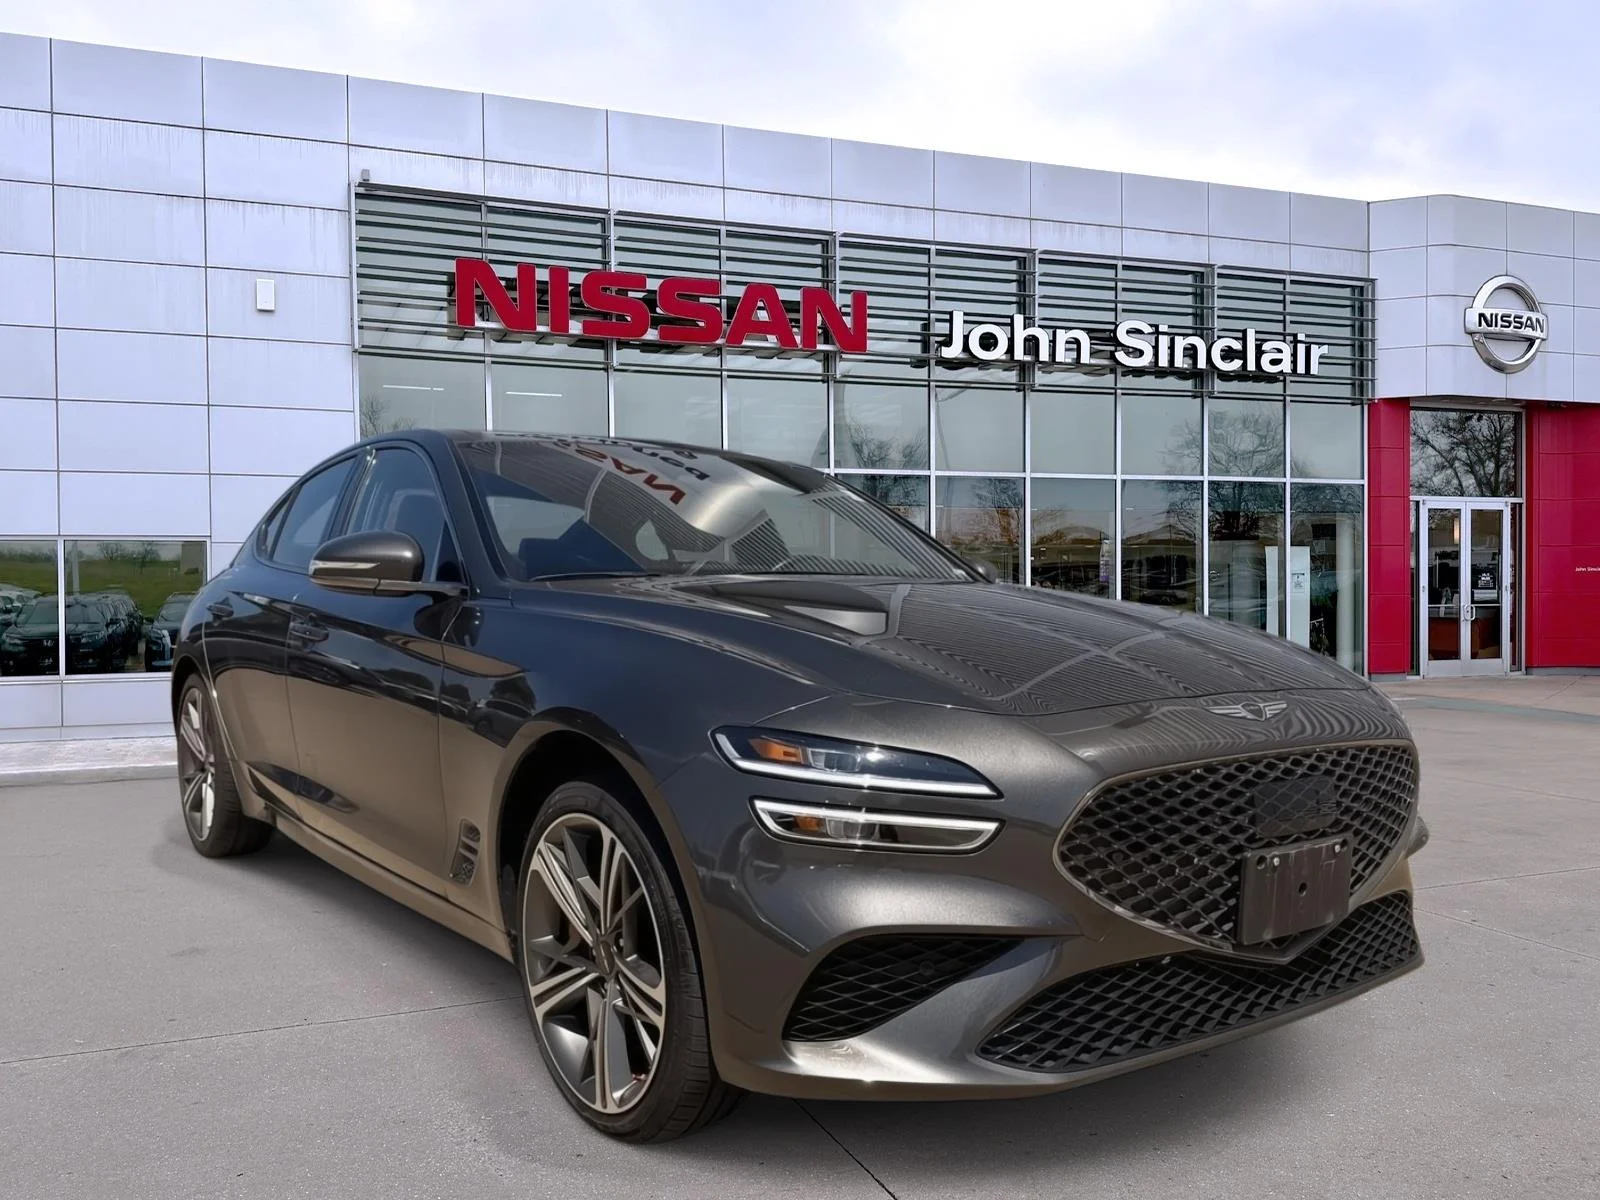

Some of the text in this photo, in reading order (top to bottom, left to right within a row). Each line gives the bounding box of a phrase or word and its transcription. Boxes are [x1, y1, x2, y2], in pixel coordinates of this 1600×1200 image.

[455, 257, 868, 353] NISSAN
[1478, 312, 1545, 333] NISSAN
[941, 310, 1329, 375] John Sinclair
